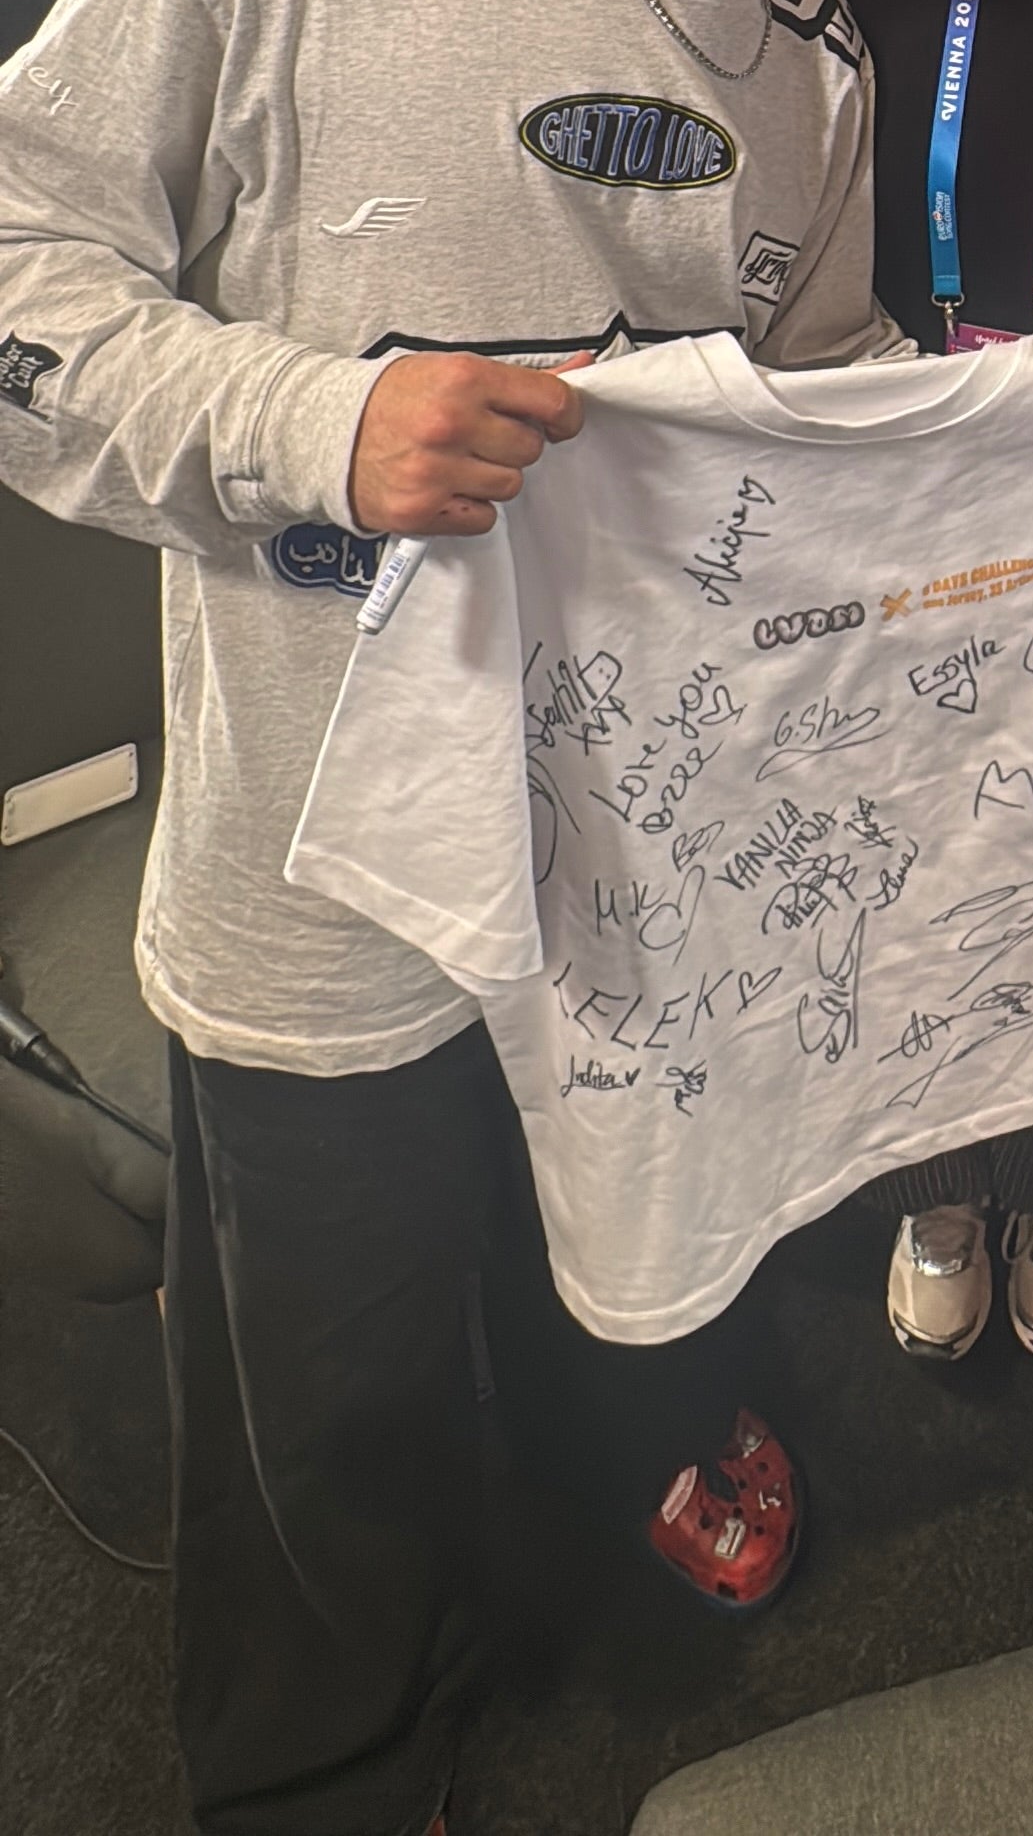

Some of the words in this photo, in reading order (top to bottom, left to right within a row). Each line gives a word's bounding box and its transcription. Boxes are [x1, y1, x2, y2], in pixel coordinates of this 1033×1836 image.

[941, 35, 968, 121] VIENNA
[539, 103, 661, 177] GHETTO
[659, 114, 724, 181] LOVE
[713, 797, 804, 891] VANILLA
[774, 806, 839, 880] NINJA
